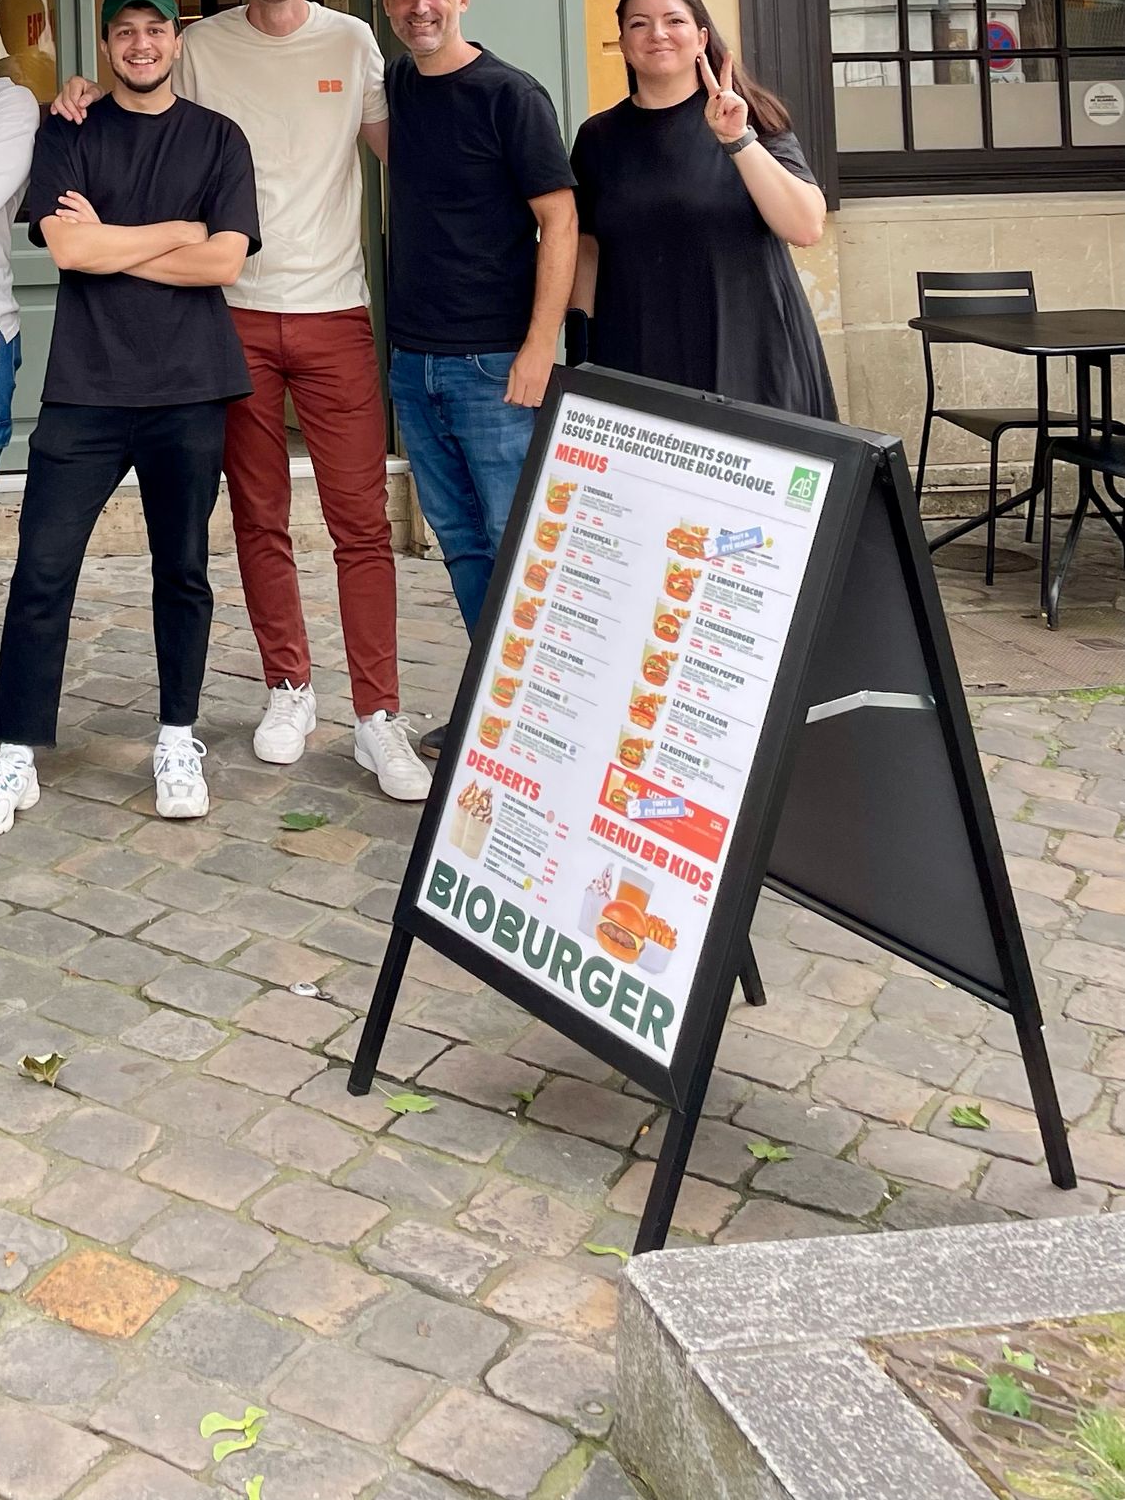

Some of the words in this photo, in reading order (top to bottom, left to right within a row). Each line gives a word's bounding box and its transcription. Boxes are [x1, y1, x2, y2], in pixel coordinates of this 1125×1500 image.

[565, 408, 596, 427] 100%
[596, 417, 612, 432] DE
[611, 421, 636, 438] NOS
[635, 425, 716, 460] INGRÉDIENTS
[715, 450, 751, 471] SONT
[553, 443, 609, 474] MENUS
[561, 423, 593, 441] ISSUS
[592, 431, 608, 446] DE
[694, 460, 777, 496] BIOLOGIQUE.
[789, 476, 813, 499] AB
[707, 573, 716, 581] LE
[740, 584, 763, 598] BACON
[695, 617, 703, 625] LE
[703, 620, 755, 645] CHEESEBURGER
[684, 655, 693, 664] LE
[693, 658, 718, 674] FRENCH
[718, 669, 744, 685] PEPPER
[671, 698, 680, 708] LE
[680, 702, 706, 719] POULET
[705, 713, 728, 728] BACON
[660, 741, 668, 750] LE
[668, 745, 701, 766] RUSTIQUE
[465, 748, 542, 803] DESSERTS
[590, 813, 641, 855] MENU
[639, 839, 670, 870] BB
[667, 853, 714, 894] KIDS
[426, 859, 675, 1052] BIOBURGER
